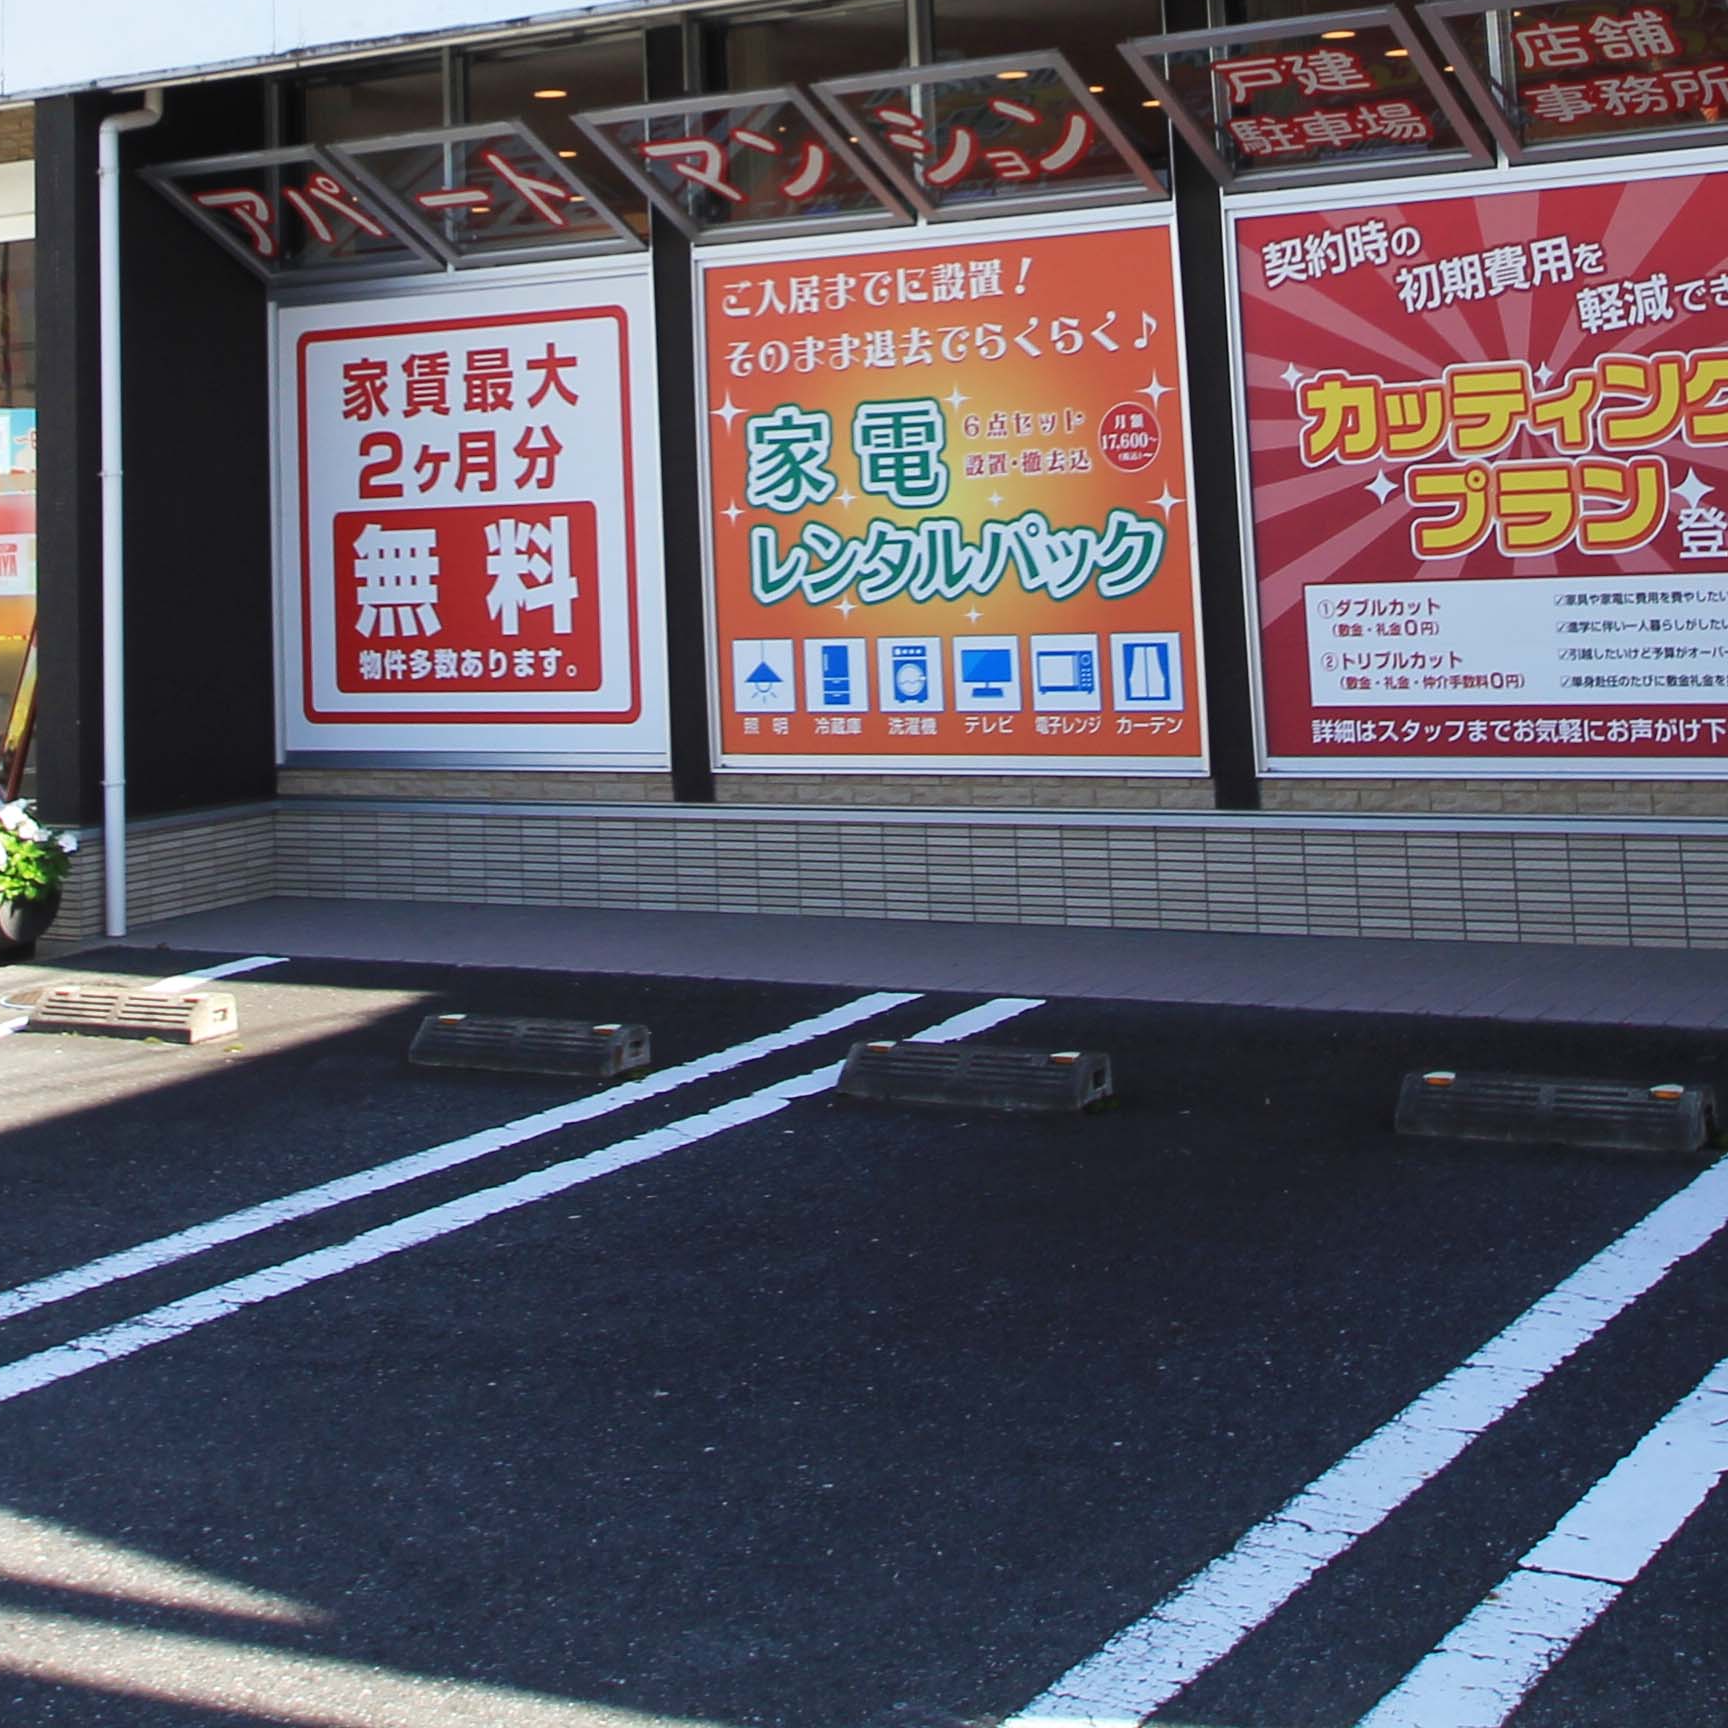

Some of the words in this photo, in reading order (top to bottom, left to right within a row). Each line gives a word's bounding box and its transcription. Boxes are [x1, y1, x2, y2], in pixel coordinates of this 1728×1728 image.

[1511, 8, 1677, 71] 店舗
[1211, 49, 1375, 105] 戸建
[639, 98, 1093, 203] マンション
[1228, 99, 1431, 157] 駐車場
[193, 151, 572, 256] アパート
[1262, 222, 1422, 288] 契約時の
[1396, 234, 1606, 315] 初期費用を
[722, 258, 1034, 317] ご入居までに設置!
[341, 342, 579, 422] 家賃最大
[964, 409, 1085, 437] 6点セット
[745, 397, 948, 513] 家電
[966, 449, 1091, 476] 設置・撤去込
[1405, 455, 1670, 560] プラン
[353, 515, 581, 637] 無料
[749, 509, 1165, 605] レンタルパック
[358, 648, 579, 681] 物件多数あります。
[814, 717, 862, 735] 冷蔵庫
[888, 717, 938, 736] 洗濯機
[965, 715, 1013, 734] テレビ
[1035, 716, 1102, 735] 電子レンジ
[1116, 716, 1184, 735] カーテン
